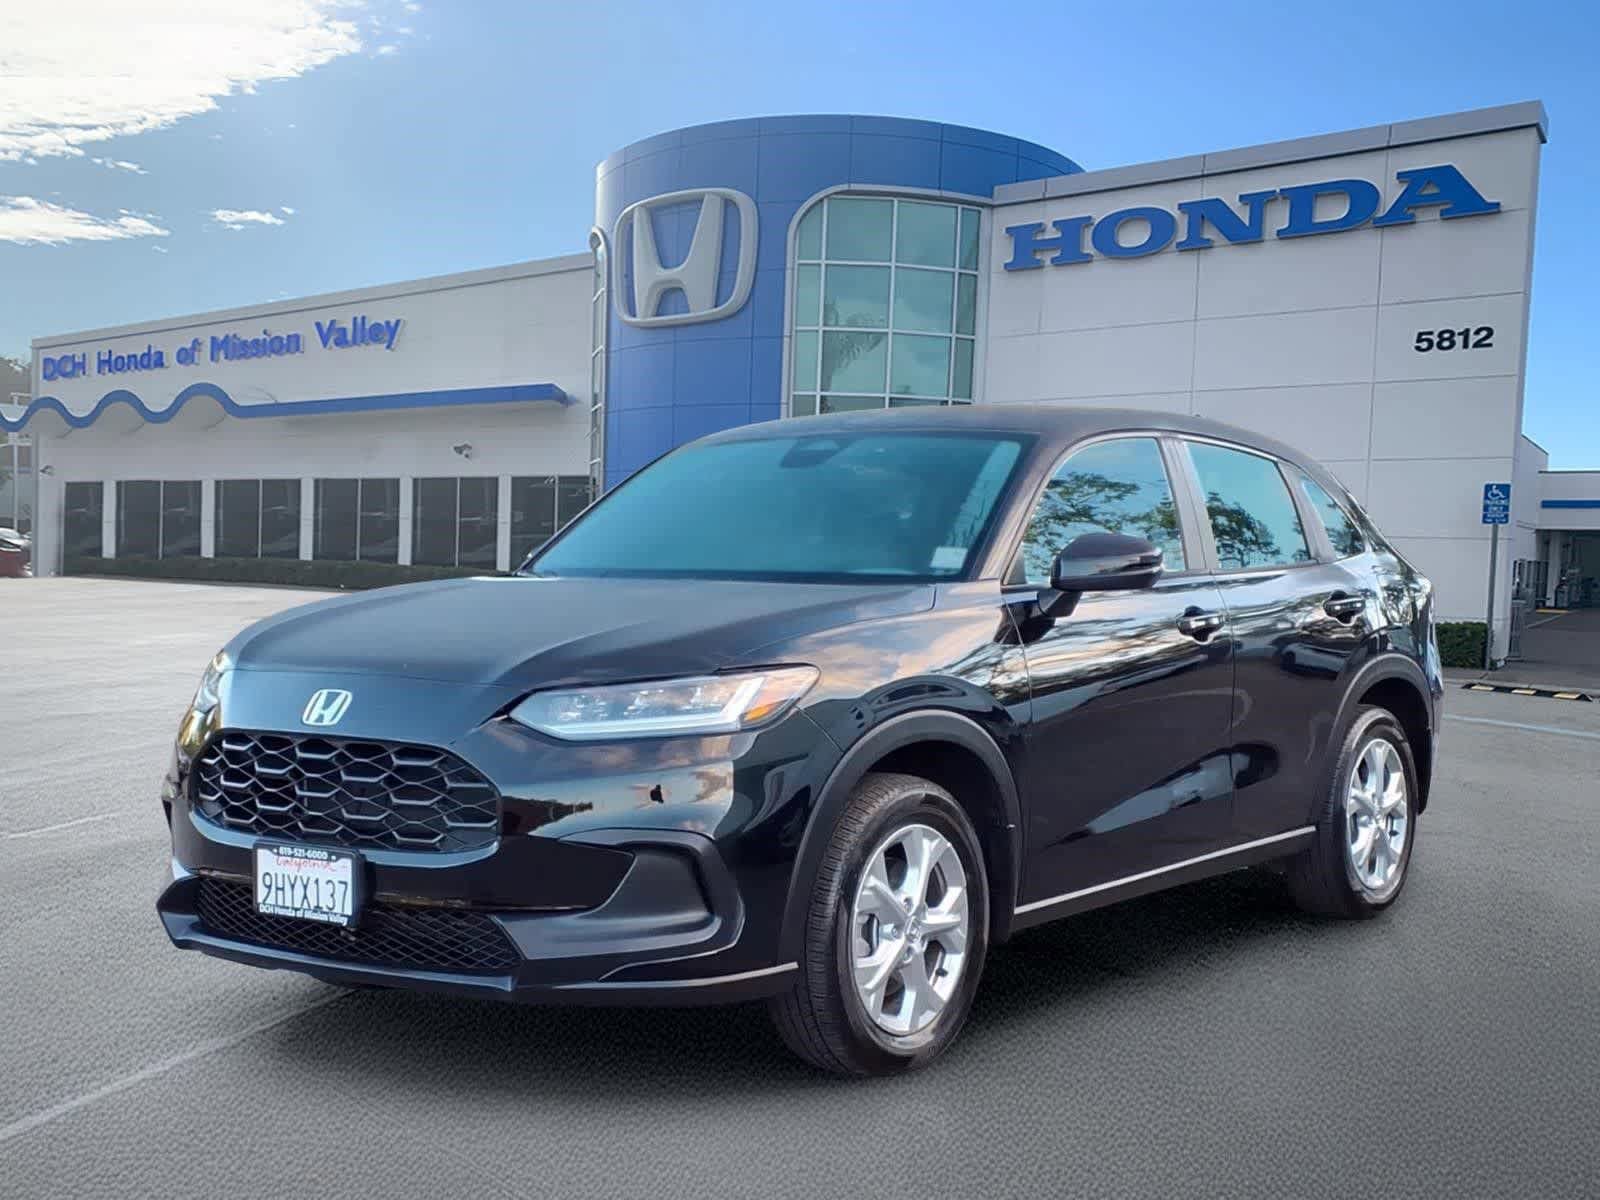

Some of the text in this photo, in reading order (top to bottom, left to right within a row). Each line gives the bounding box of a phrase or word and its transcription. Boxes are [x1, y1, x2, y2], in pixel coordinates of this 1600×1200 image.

[1003, 164, 1501, 272] HONDA
[42, 315, 401, 381] DCH Honda of Mission Valley
[1414, 326, 1494, 352] 5812
[262, 871, 348, 913] 9HYX137
